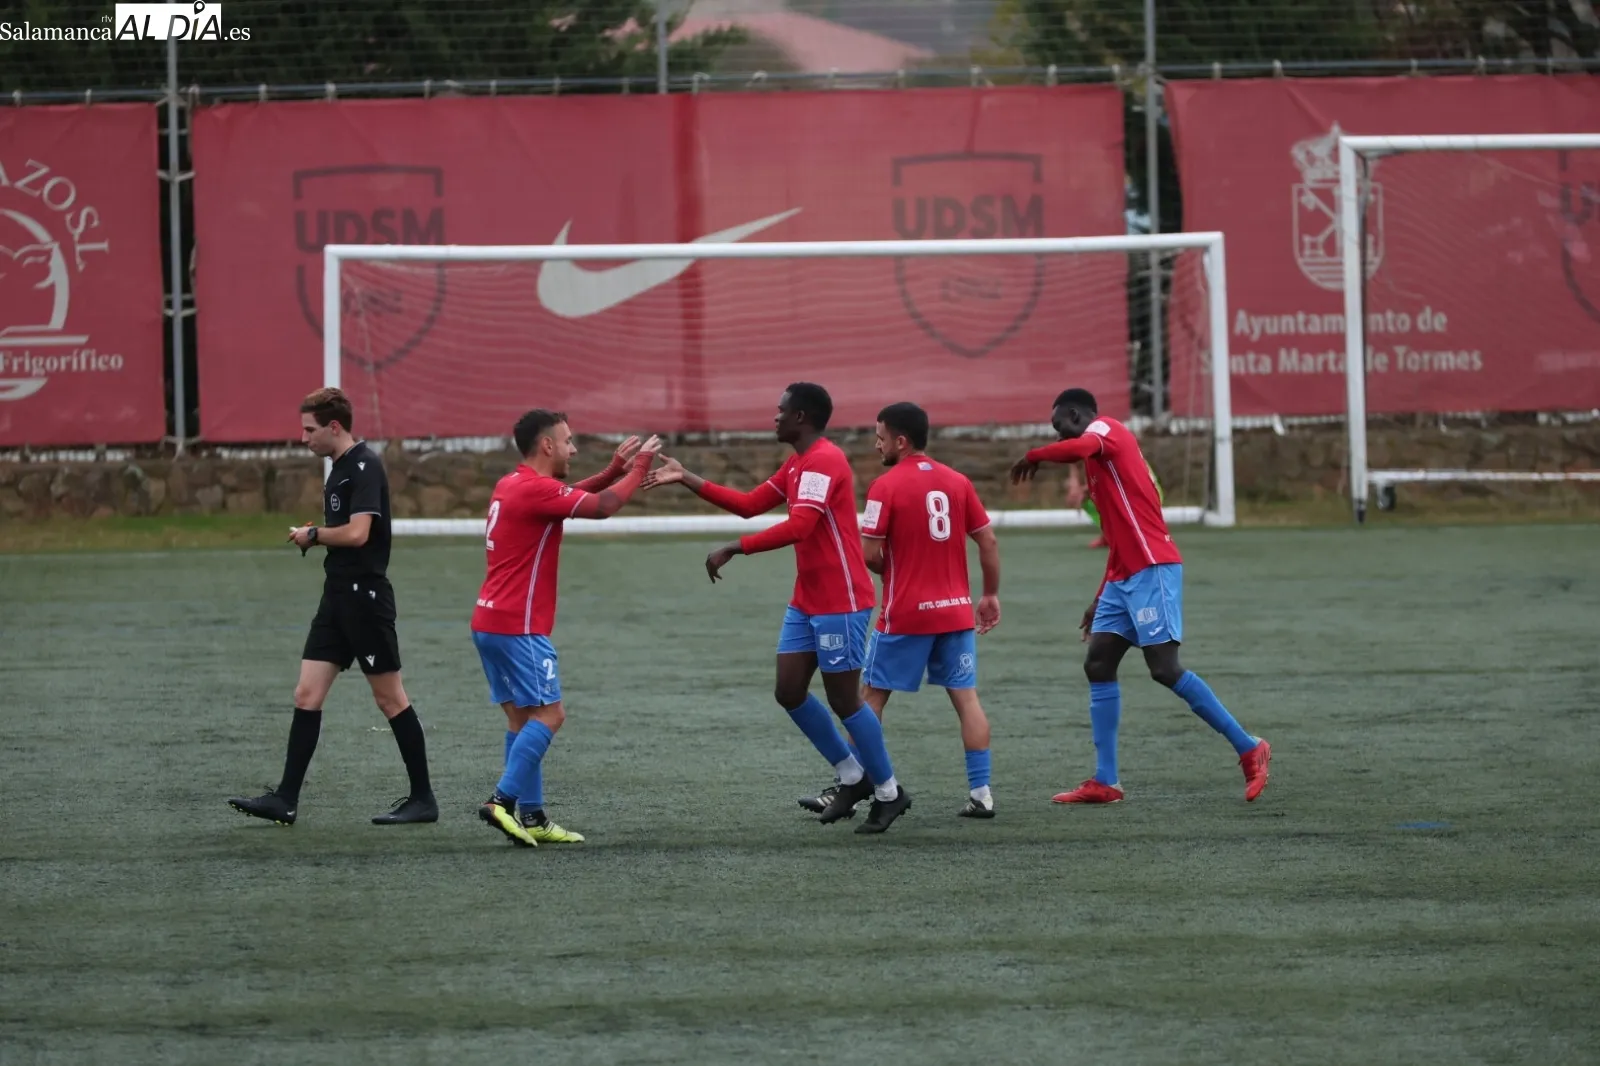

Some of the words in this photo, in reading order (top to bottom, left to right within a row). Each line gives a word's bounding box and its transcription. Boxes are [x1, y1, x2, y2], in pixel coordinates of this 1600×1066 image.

[294, 207, 445, 254] UDSM
[892, 193, 1044, 241] UDSM
[1234, 309, 1411, 342] Ayuntamnto
[1416, 306, 1448, 332] de
[0, 348, 124, 377] Frigorífico
[1200, 349, 1272, 375] Snta
[1394, 345, 1483, 372] Tormes
[486, 500, 500, 550] 2
[925, 490, 951, 542] 8
[543, 658, 556, 681] 2
